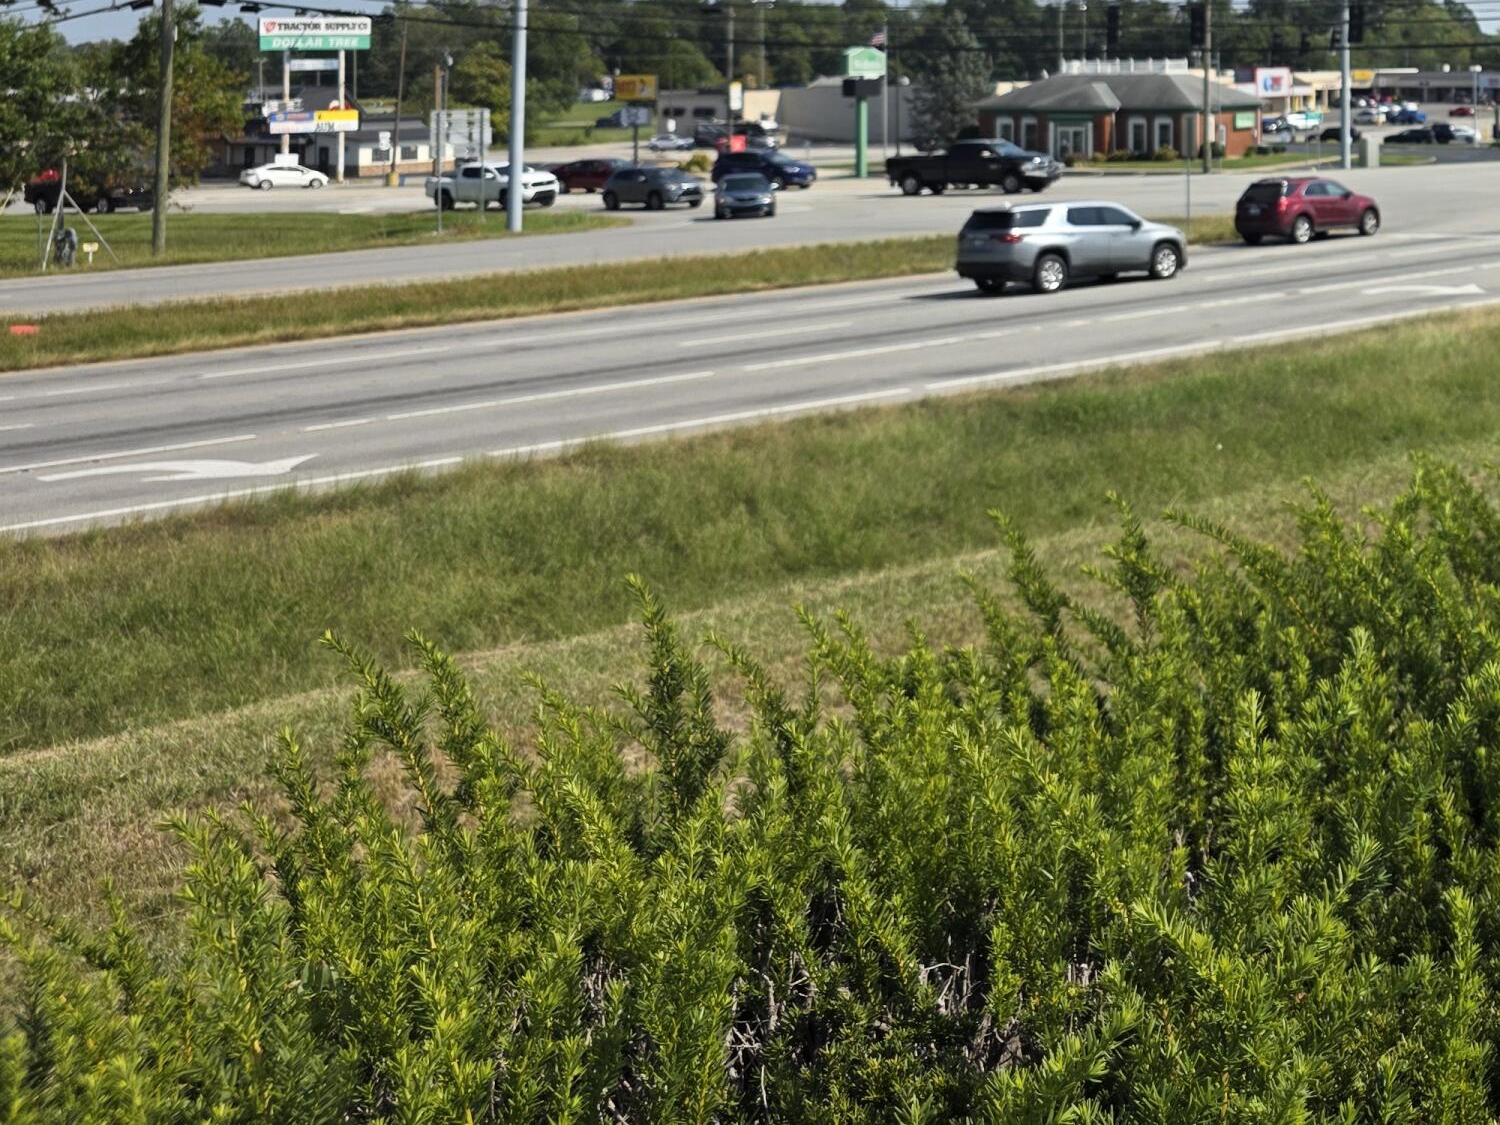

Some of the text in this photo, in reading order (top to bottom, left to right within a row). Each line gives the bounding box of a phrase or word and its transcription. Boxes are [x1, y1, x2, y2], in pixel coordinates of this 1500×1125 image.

[277, 22, 321, 31] TRACTOR
[325, 22, 355, 31] SUPPLY
[272, 37, 359, 48] DOLLAR TREE
